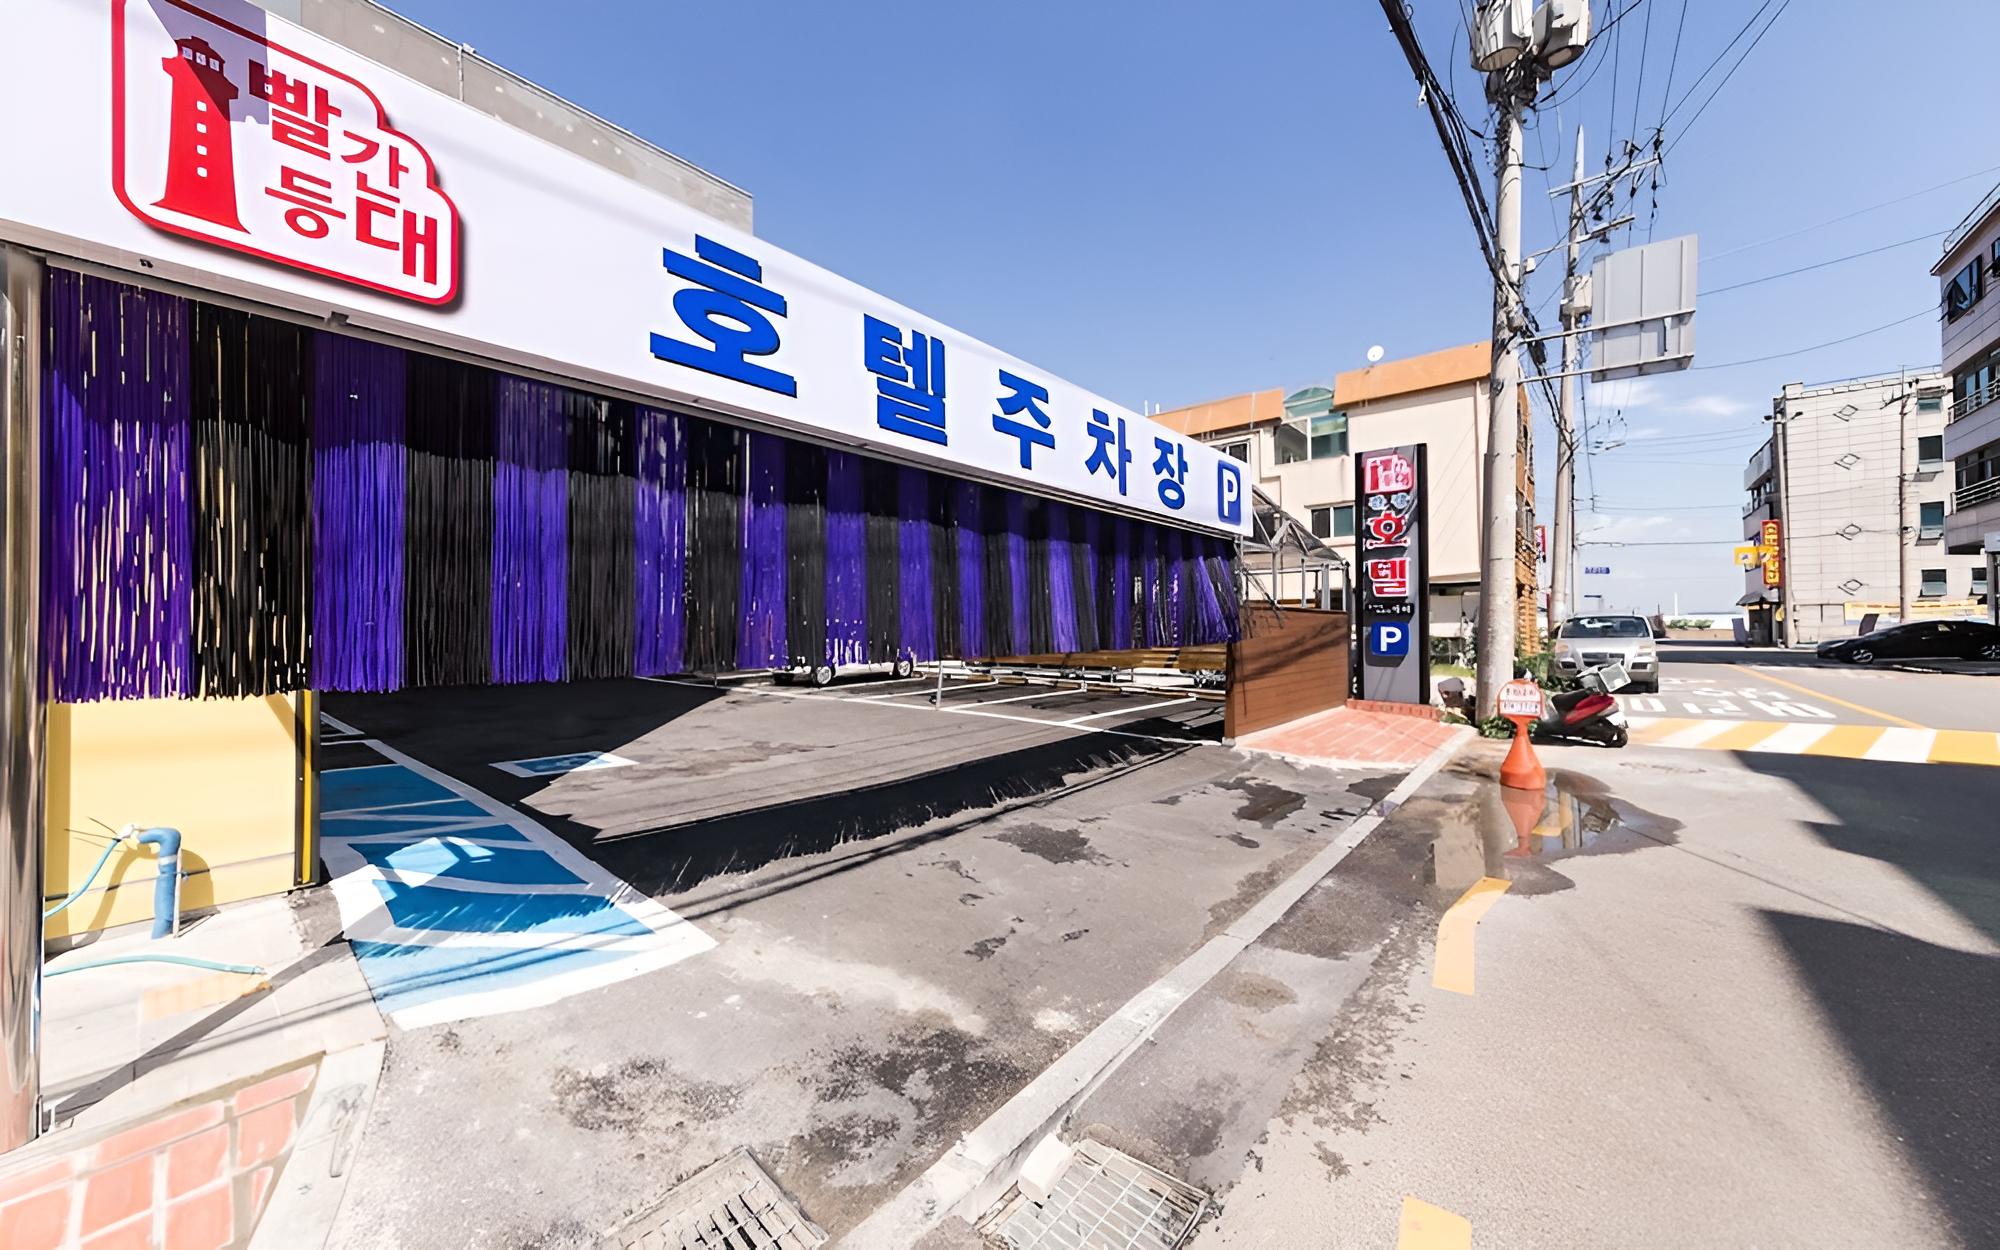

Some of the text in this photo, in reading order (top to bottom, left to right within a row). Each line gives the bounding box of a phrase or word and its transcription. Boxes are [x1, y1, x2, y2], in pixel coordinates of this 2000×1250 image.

[248, 58, 410, 203] 빨간
[265, 165, 438, 284] 등대
[1222, 471, 1240, 518] P
[1380, 626, 1402, 652] P
